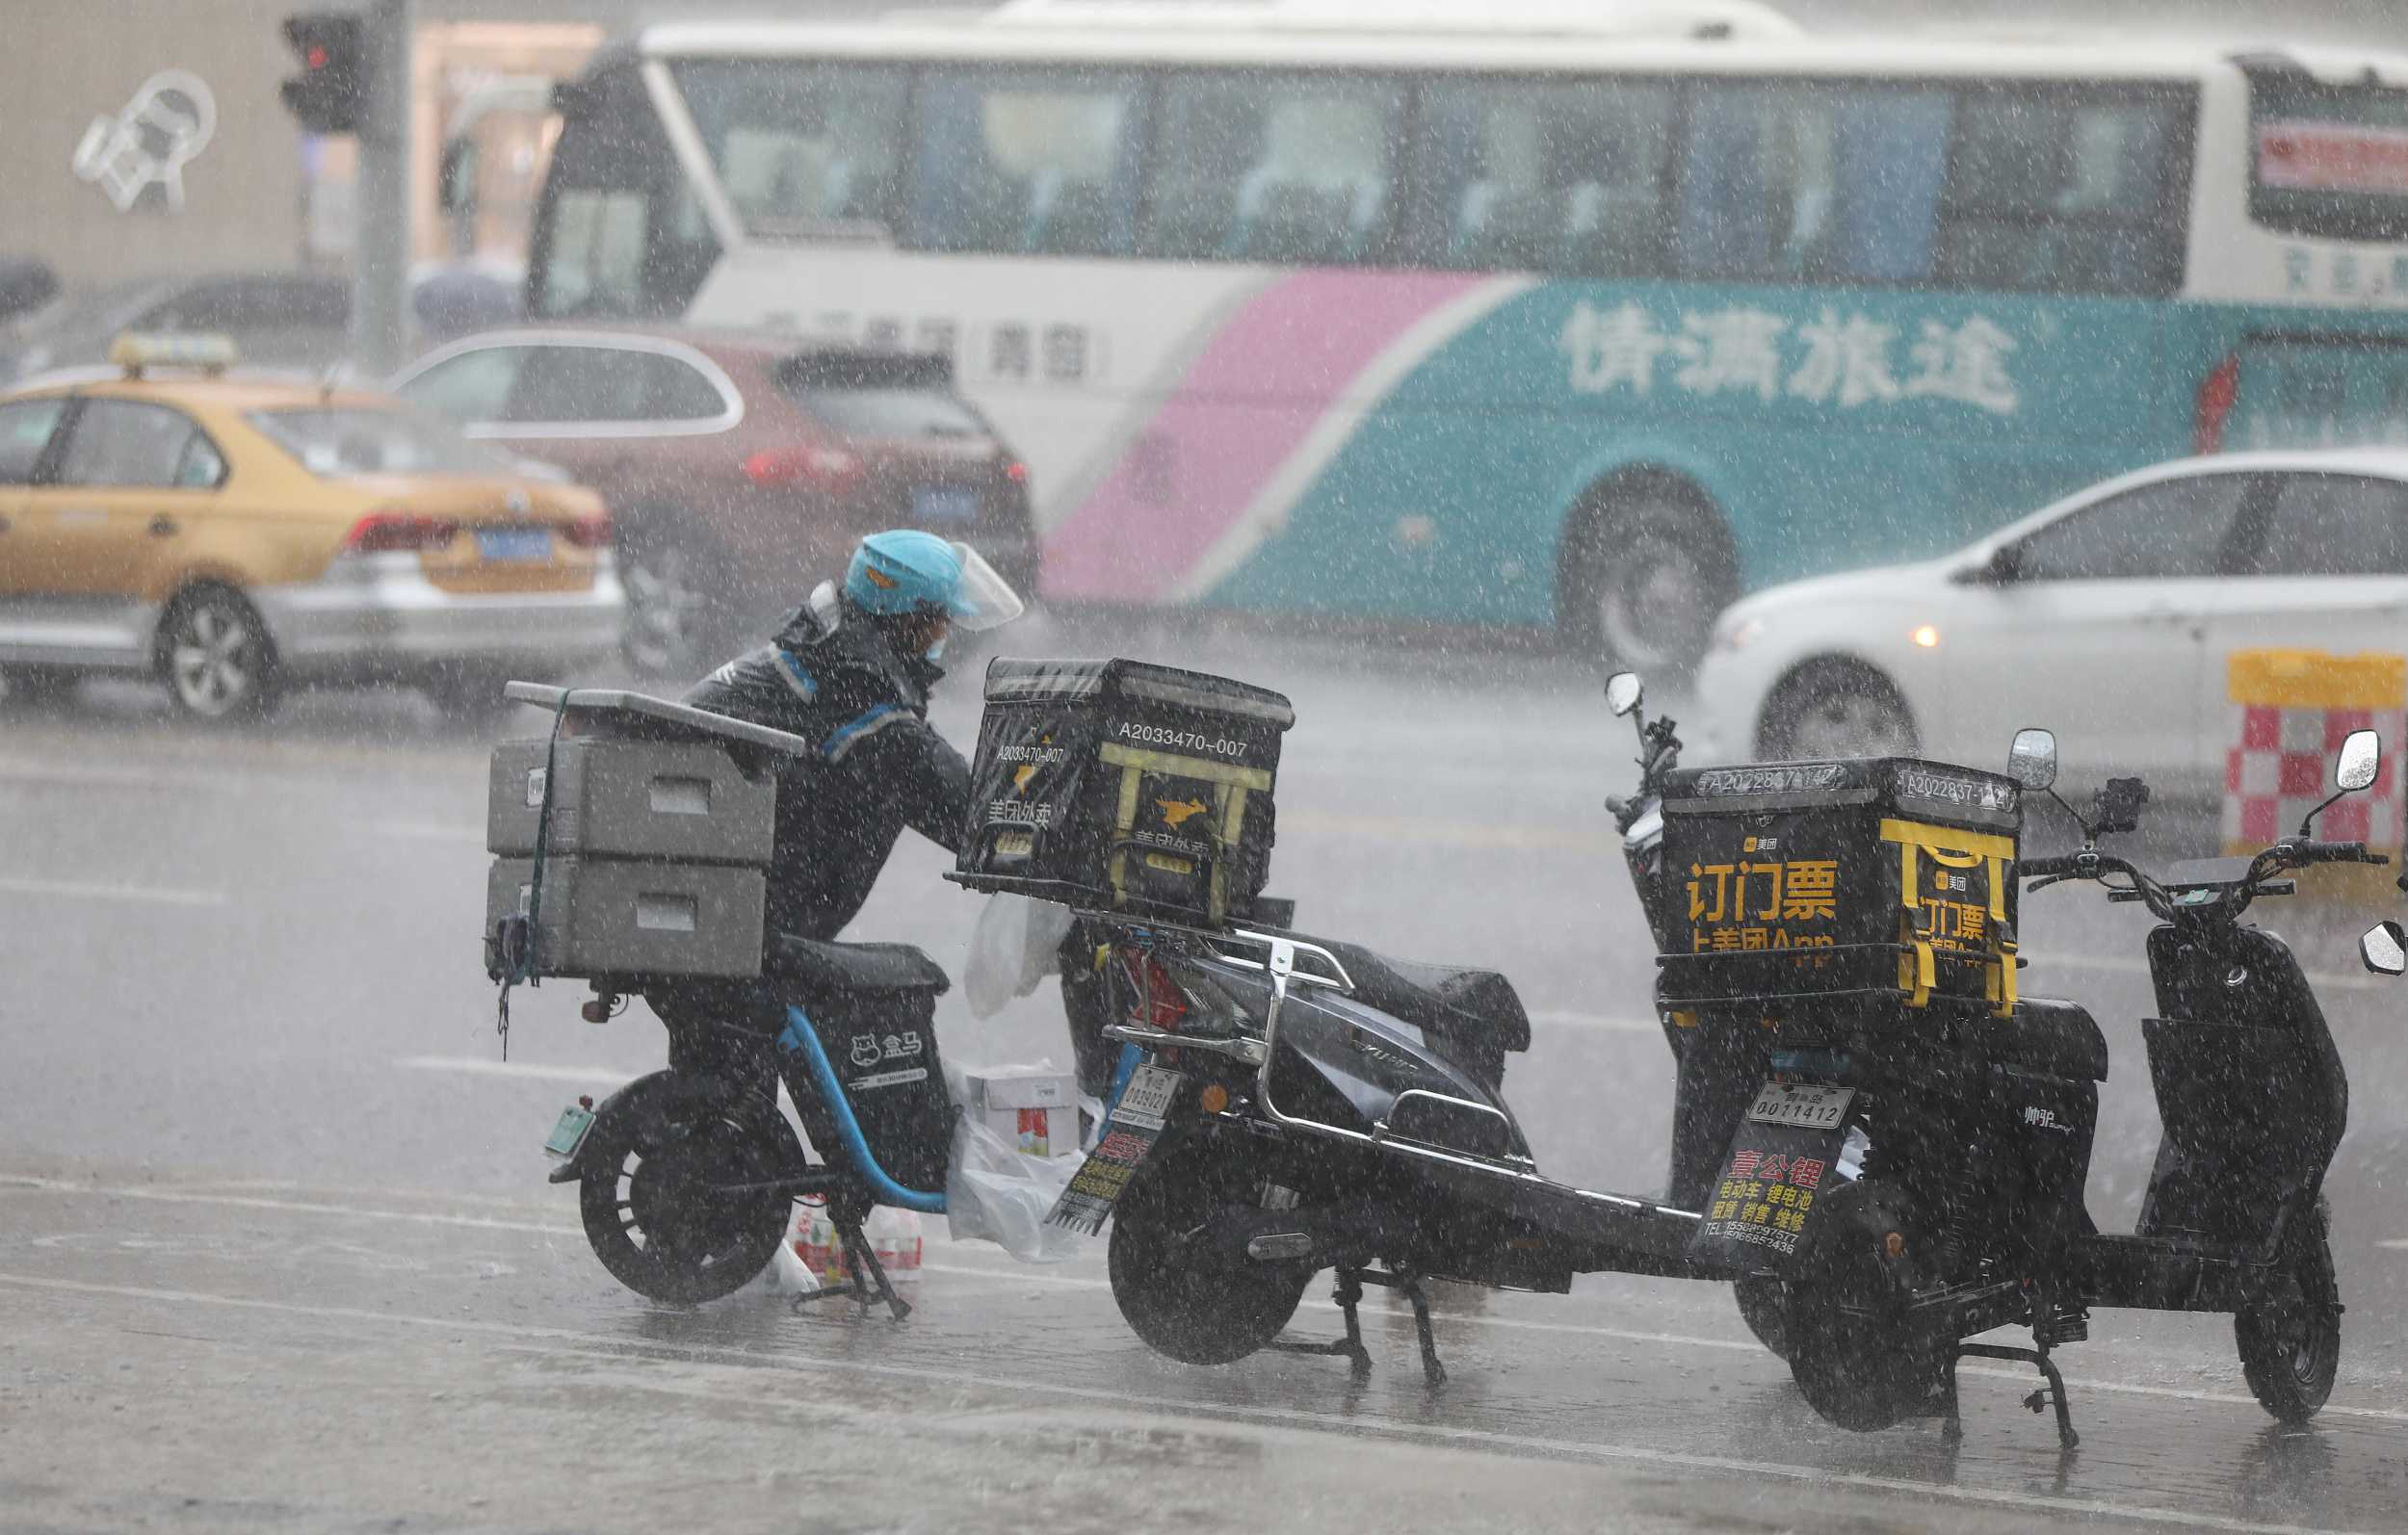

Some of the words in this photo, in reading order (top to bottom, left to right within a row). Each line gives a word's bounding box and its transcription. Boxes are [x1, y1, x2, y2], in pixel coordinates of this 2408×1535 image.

[1557, 301, 2020, 414] 情满旅途
[997, 744, 1064, 764] A2033470-007
[1119, 723, 1247, 757] A2033470-007
[988, 798, 1053, 829] 美团外卖
[1756, 838, 1777, 850] 美团
[1686, 859, 1839, 923] 订门票
[1948, 874, 1967, 892] 美团
[882, 1031, 922, 1057] 盒马
[1756, 1101, 1839, 1122] 0011412
[1726, 1149, 1826, 1190] 壹公锂
[1719, 1180, 1763, 1201] 电动车
[1766, 1184, 1815, 1211] 锂电池
[1741, 1202, 1771, 1224] 销售
[1772, 1209, 1806, 1233] 维修
